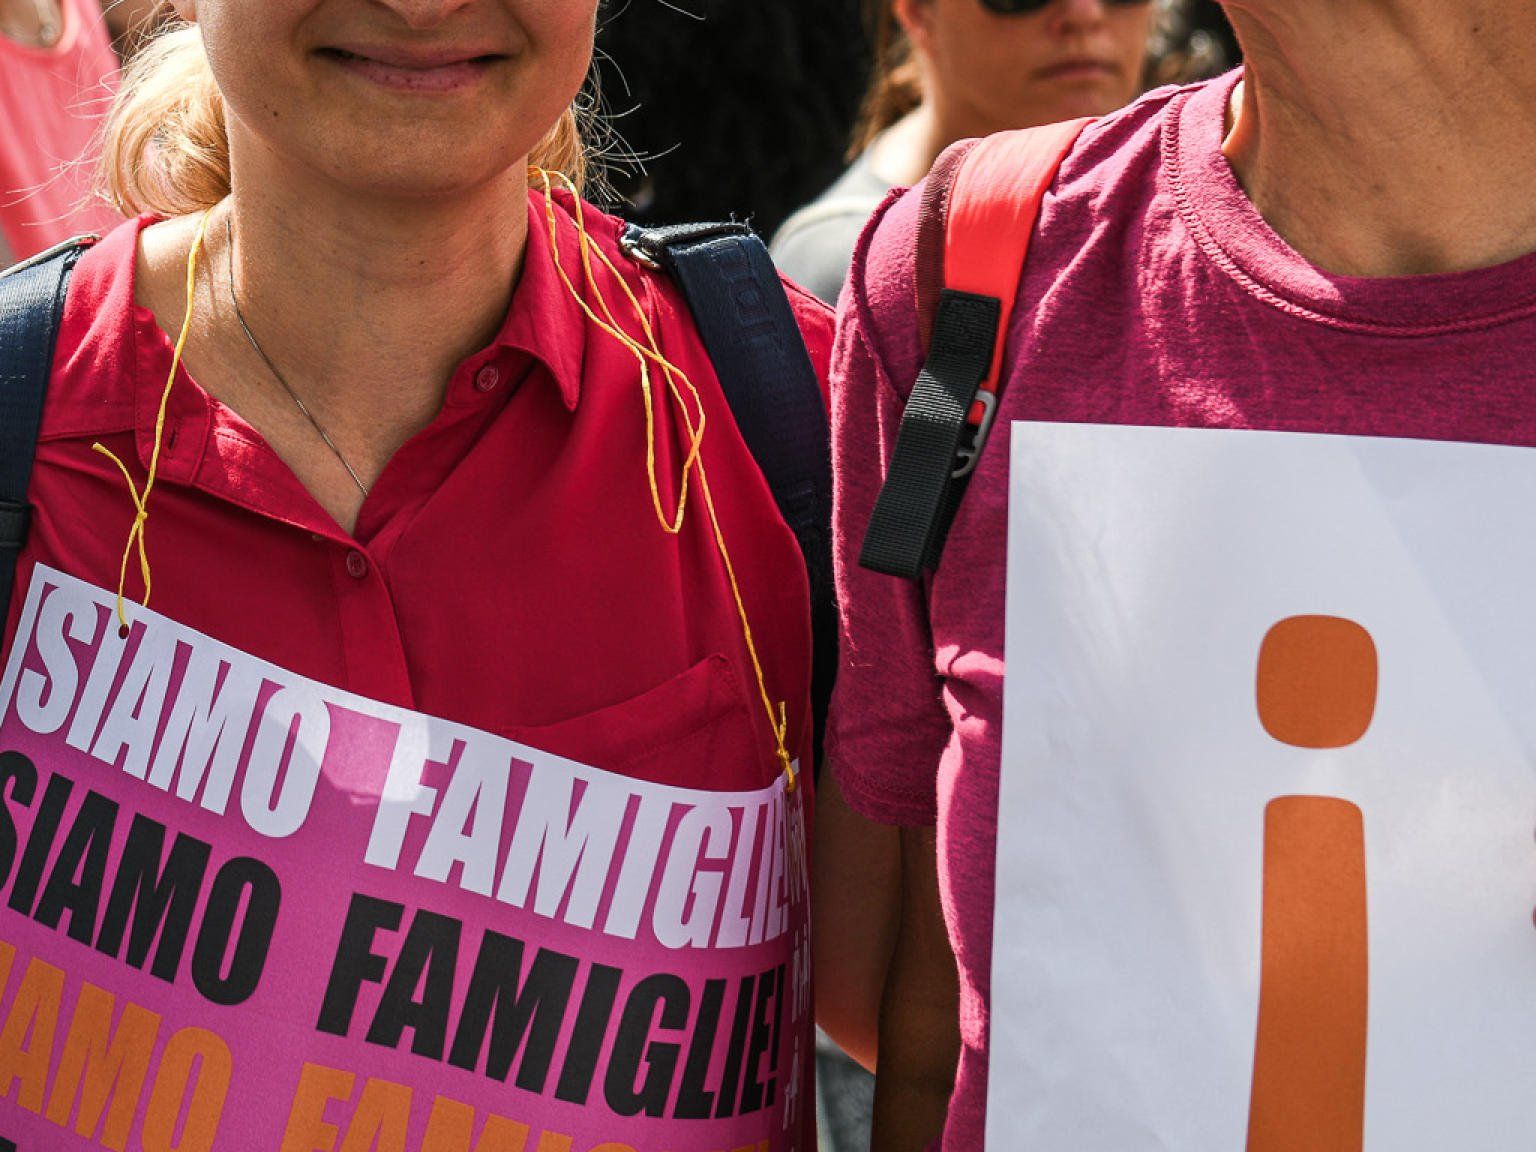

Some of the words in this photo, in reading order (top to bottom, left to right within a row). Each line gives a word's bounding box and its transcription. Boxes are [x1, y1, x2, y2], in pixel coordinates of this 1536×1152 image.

[16, 586, 331, 838] SIAMO
[316, 892, 787, 1120] FAMIGLIE!
[1246, 614, 1378, 1152] i
